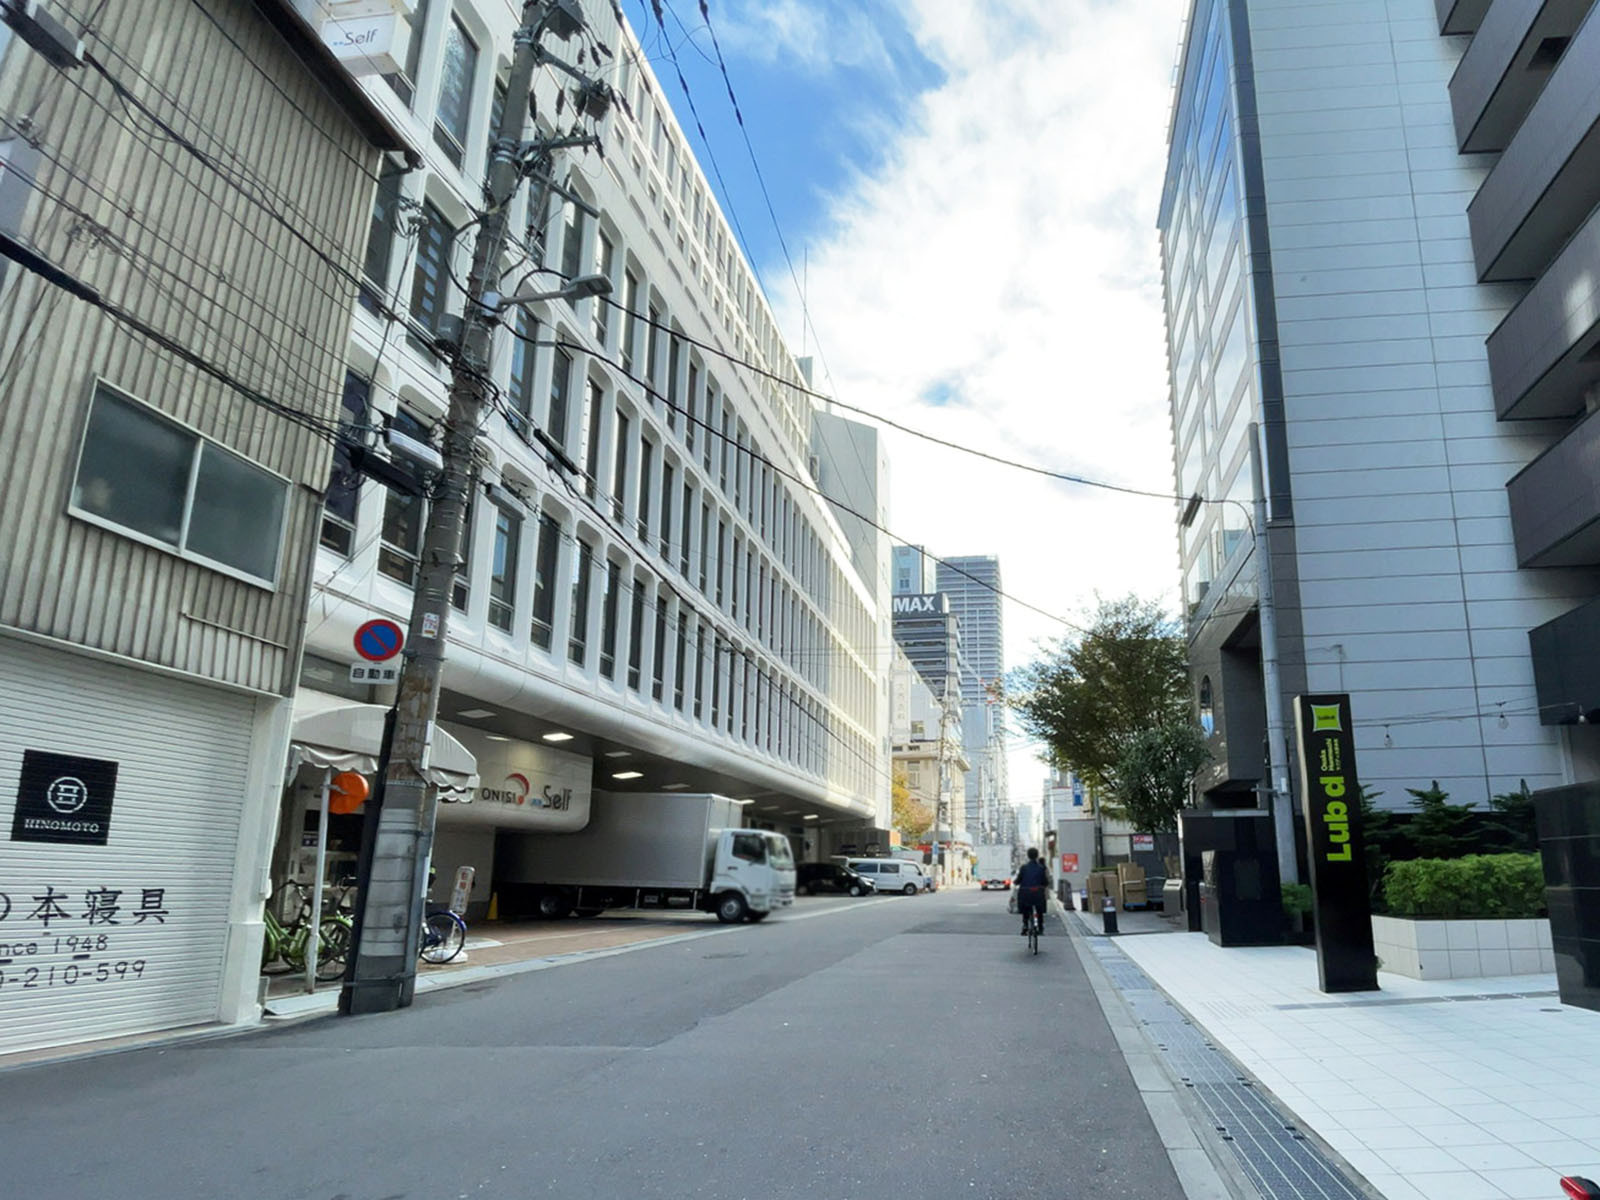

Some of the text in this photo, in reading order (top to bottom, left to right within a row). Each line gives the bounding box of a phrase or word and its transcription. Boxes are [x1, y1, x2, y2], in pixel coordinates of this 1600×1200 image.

[344, 29, 378, 46] Self
[893, 596, 935, 612] MAX
[352, 668, 395, 679] 自動車
[543, 785, 572, 811] Self
[24, 819, 100, 833] HINOMOTO
[1323, 801, 1352, 861] Lub
[54, 934, 109, 953] 1948
